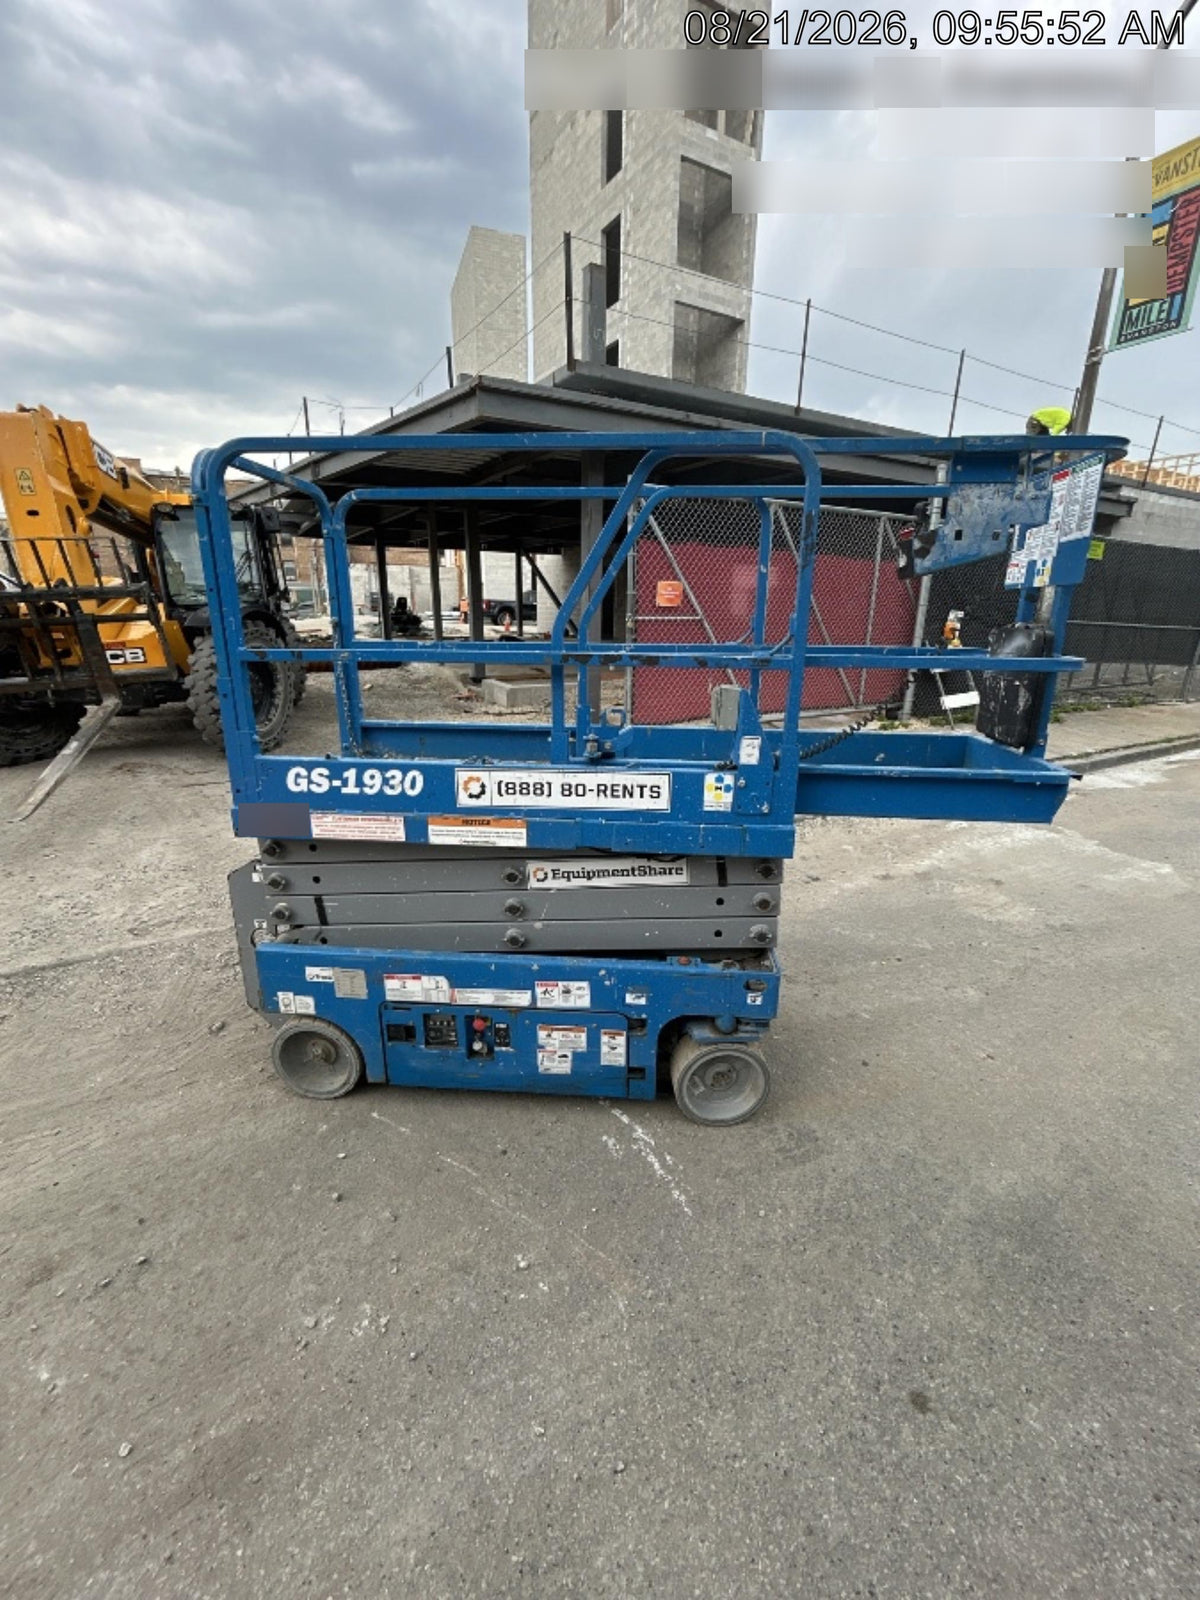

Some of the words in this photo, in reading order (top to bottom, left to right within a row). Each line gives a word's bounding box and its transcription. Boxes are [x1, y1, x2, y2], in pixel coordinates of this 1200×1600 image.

[1152, 150, 1200, 186] VANST
[1123, 299, 1169, 333] MILE
[105, 648, 145, 664] CB
[286, 767, 424, 797] GS-1930
[550, 865, 684, 882] EquipmentShare
